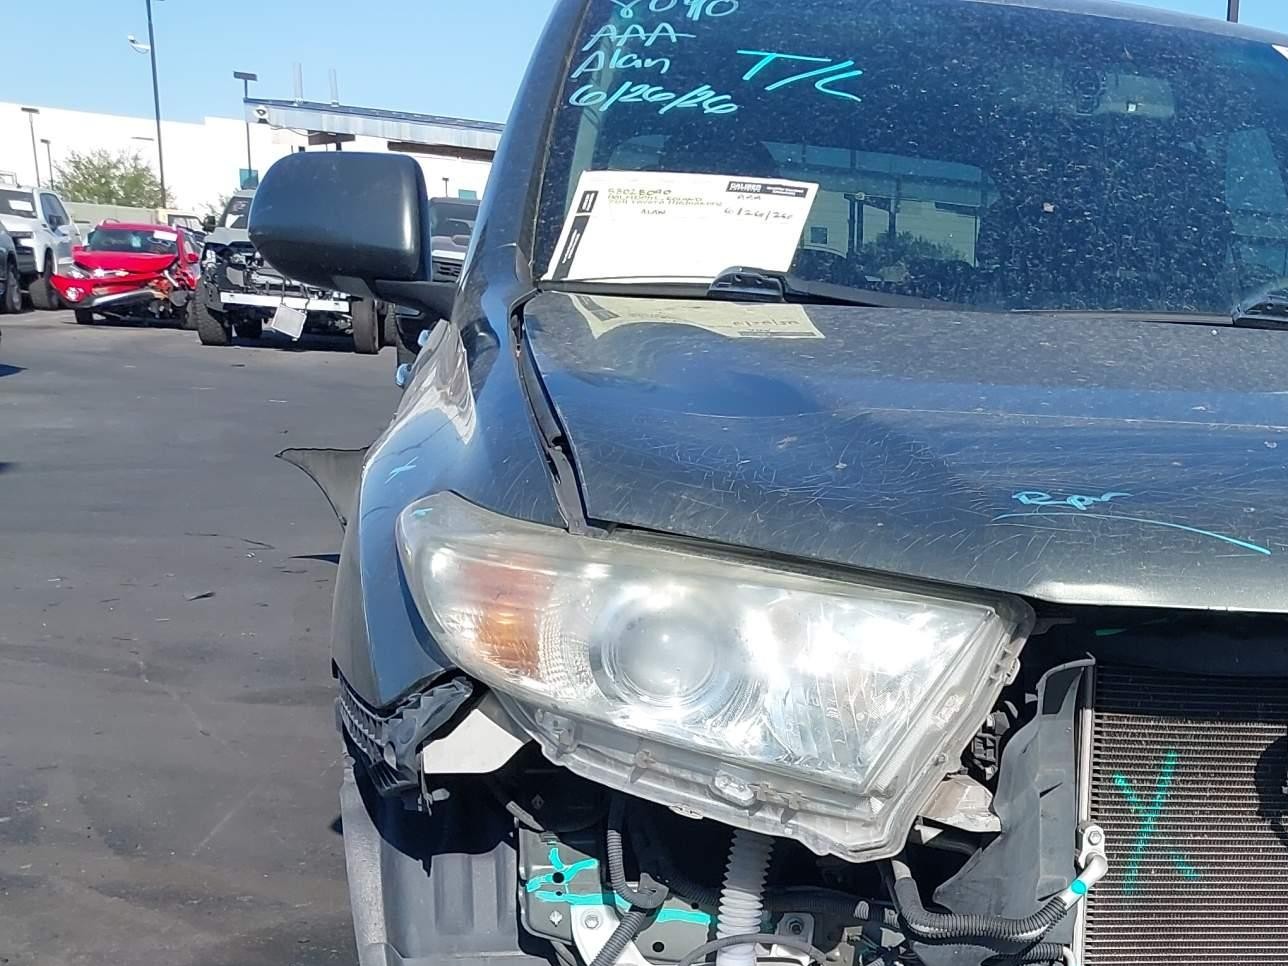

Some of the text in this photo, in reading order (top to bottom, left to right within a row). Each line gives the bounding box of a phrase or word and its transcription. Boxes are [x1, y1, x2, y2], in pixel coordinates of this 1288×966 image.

[582, 22, 697, 51] AAA
[570, 48, 671, 80] Alan
[568, 81, 739, 115] 6/26/26
